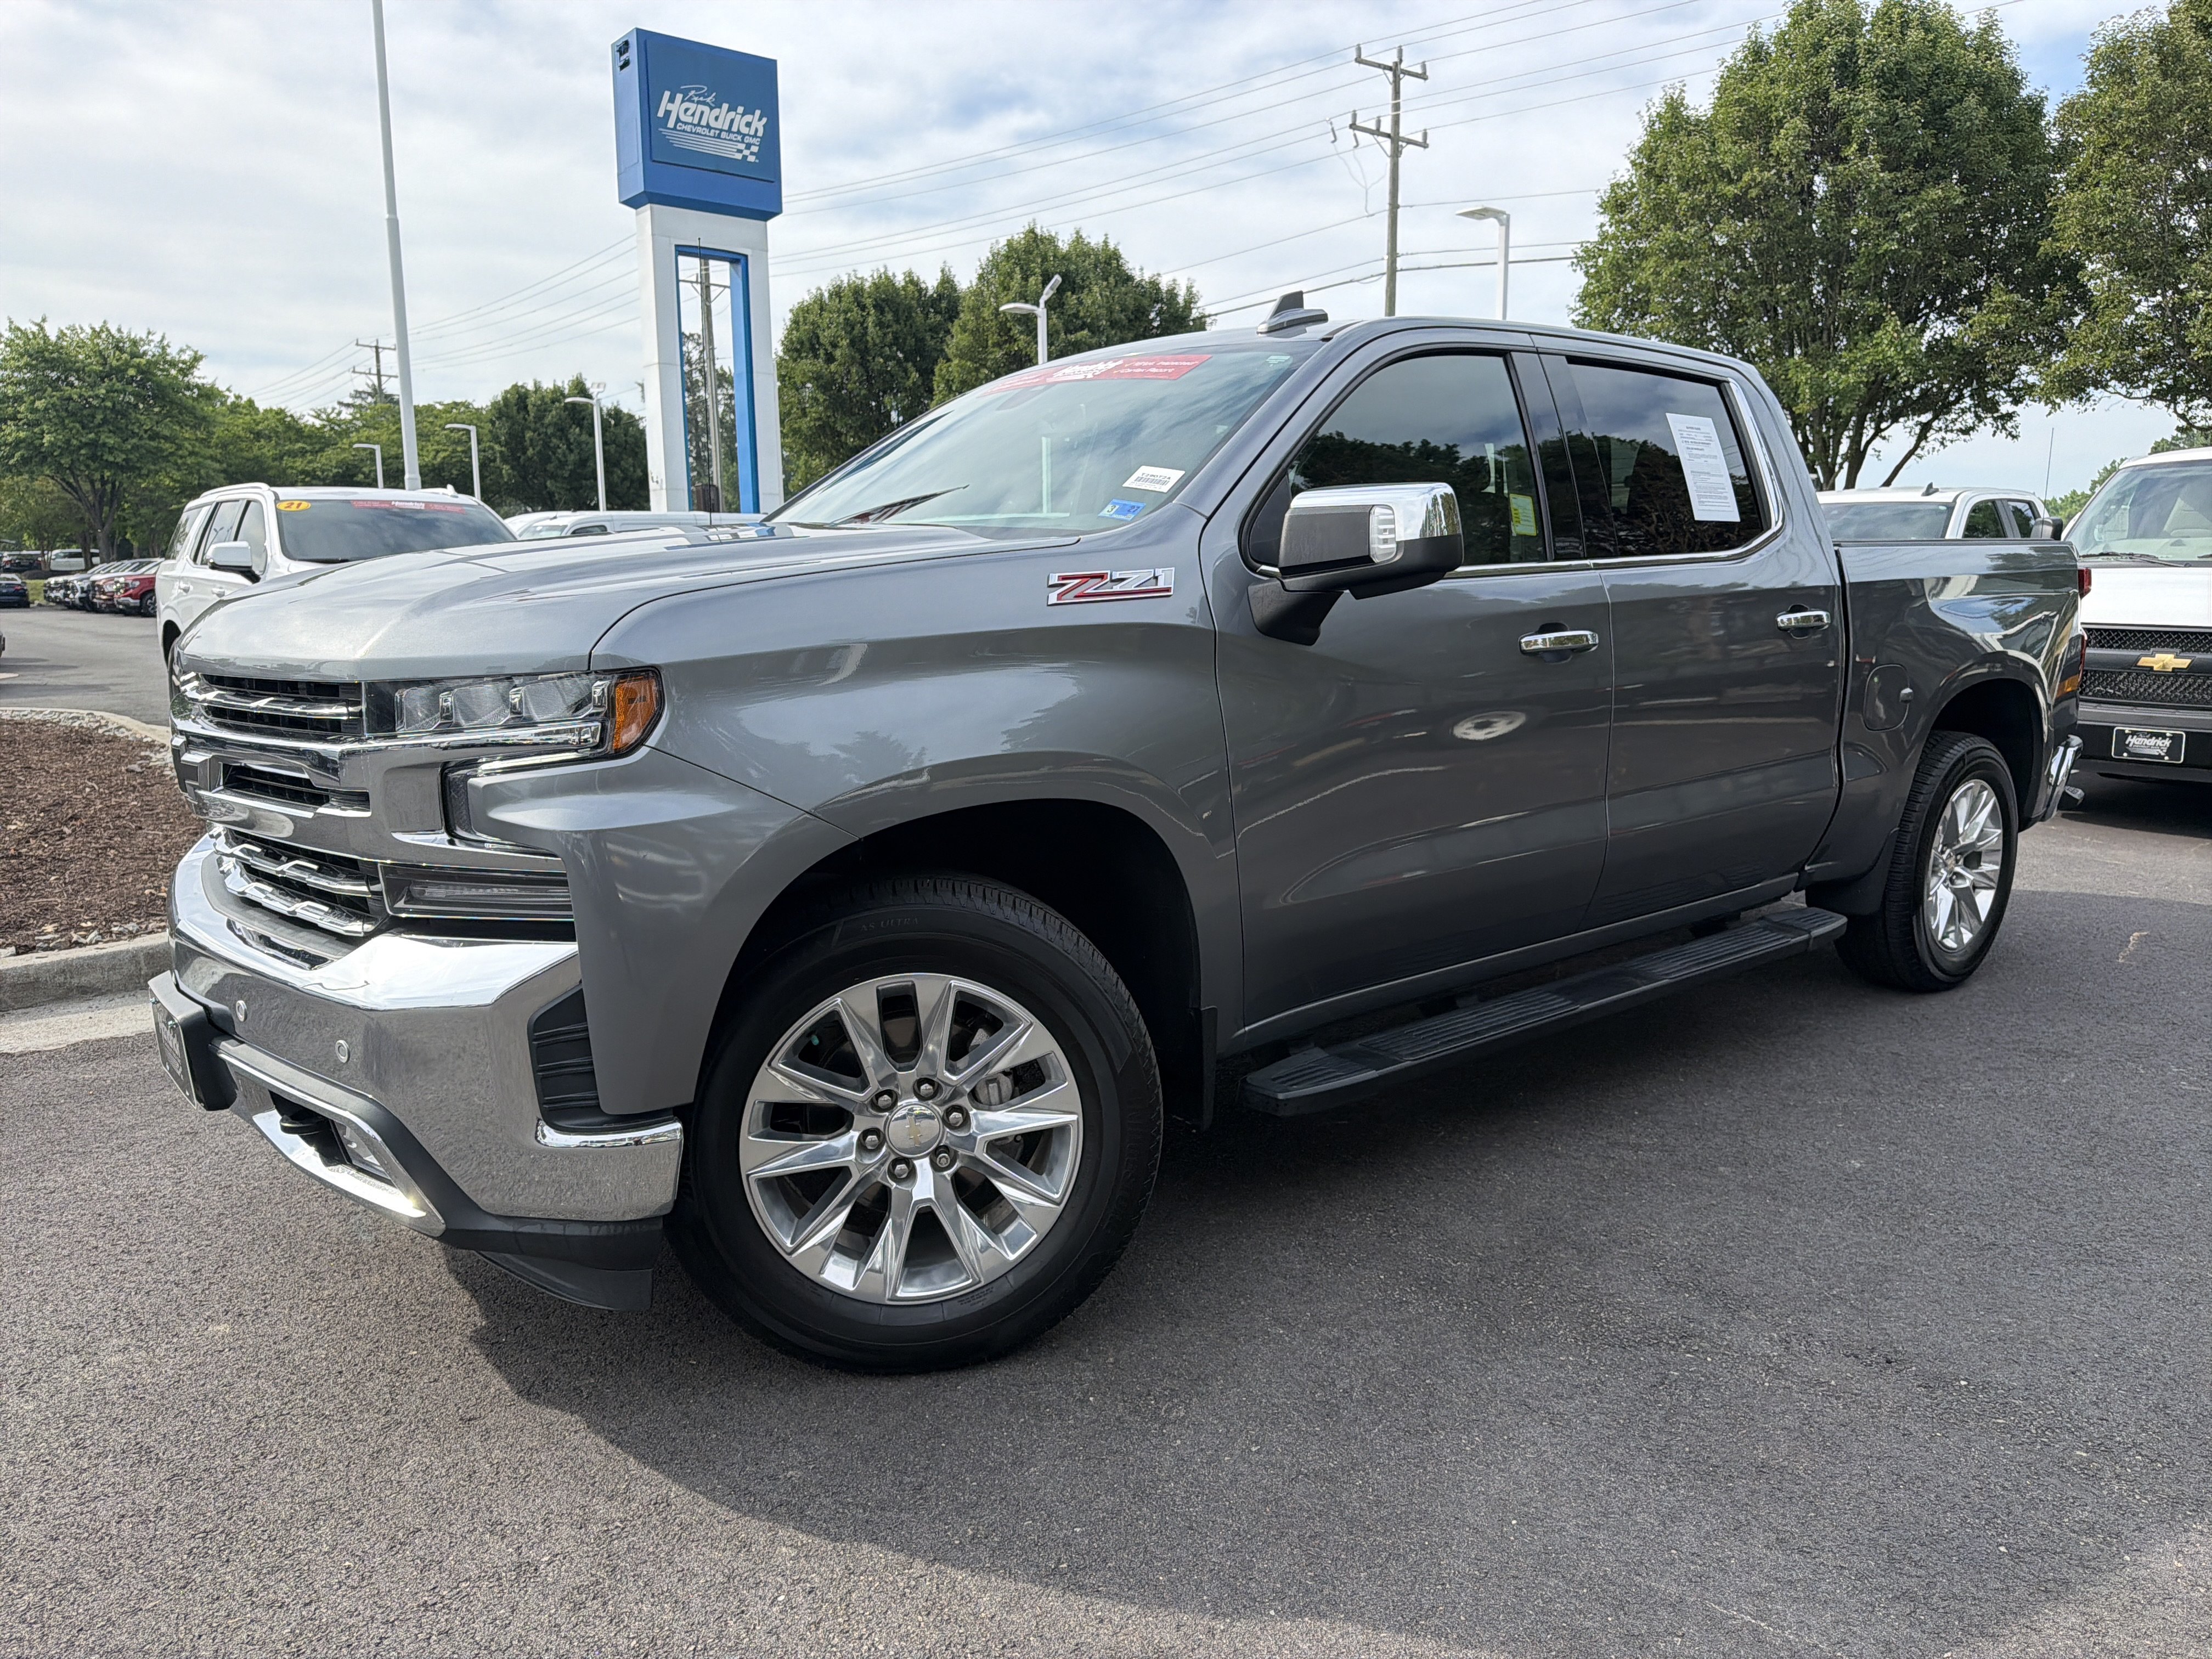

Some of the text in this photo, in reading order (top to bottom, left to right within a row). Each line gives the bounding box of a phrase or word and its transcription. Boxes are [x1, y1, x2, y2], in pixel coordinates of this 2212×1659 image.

[657, 90, 768, 137] Hendrick
[676, 122, 761, 145] CHEVROLET BUICK GMC
[1107, 505, 1116, 513] 3
[1047, 567, 1175, 606] Z71
[2125, 735, 2172, 747] Hendrick
